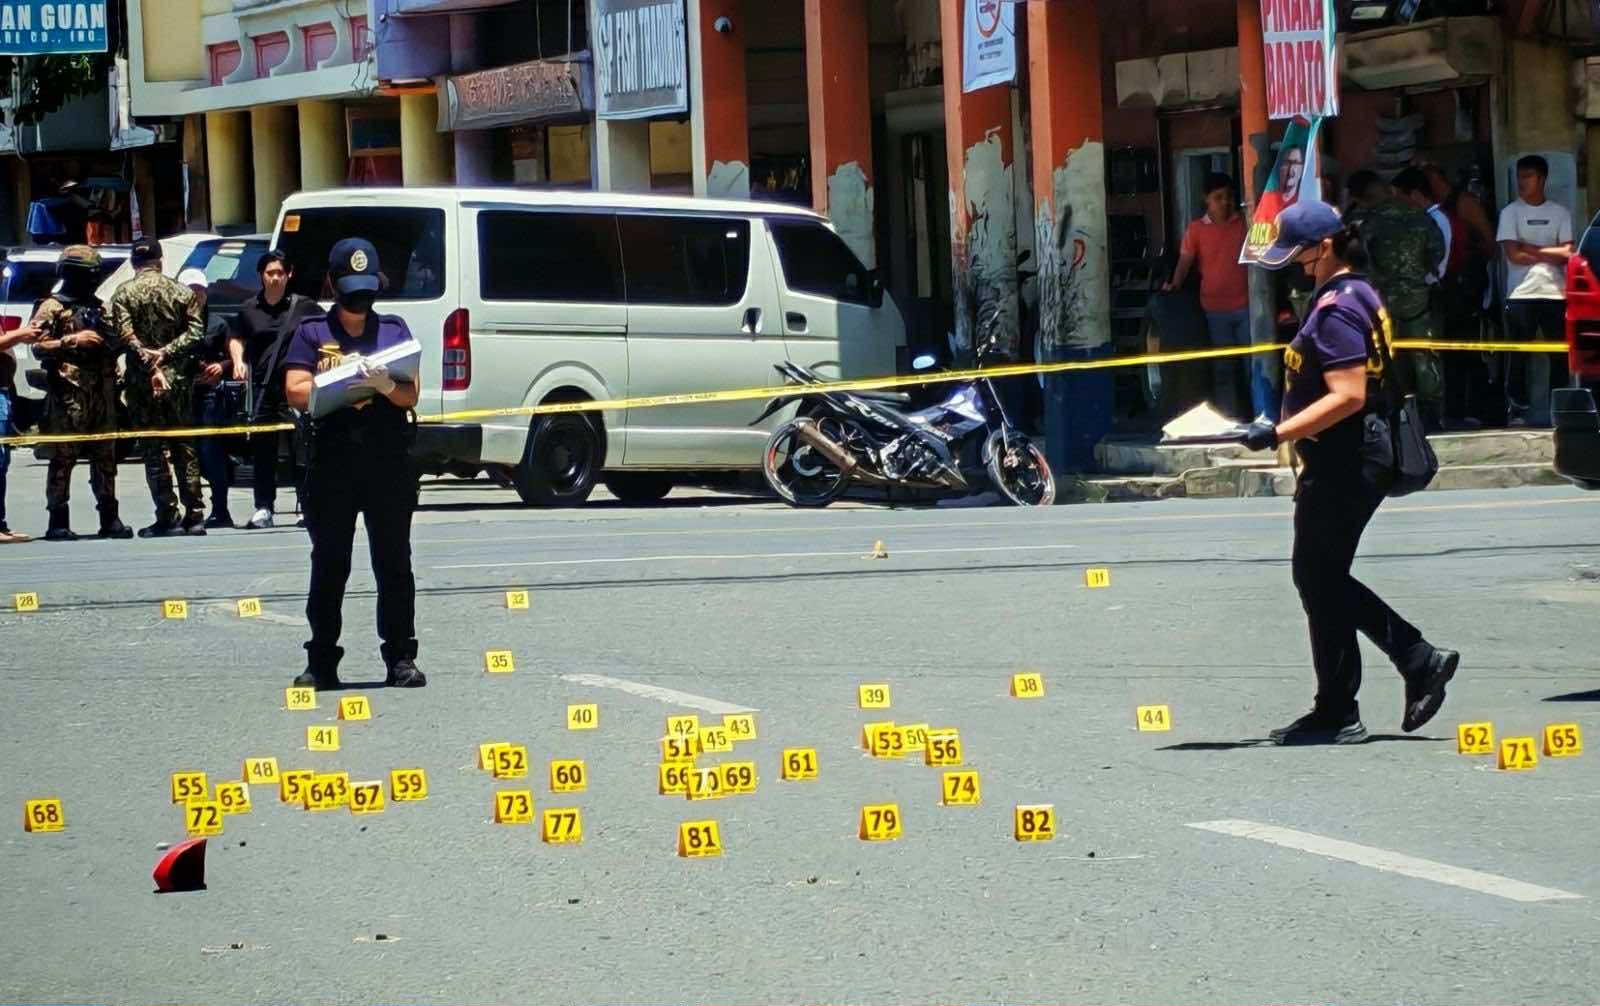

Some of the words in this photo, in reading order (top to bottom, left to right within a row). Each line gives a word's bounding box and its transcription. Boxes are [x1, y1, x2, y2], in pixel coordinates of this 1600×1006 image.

[41, 4, 104, 29] GUAN
[1264, 40, 1326, 112] BARATO
[491, 655, 508, 668] 35
[292, 690, 310, 704] 36
[865, 689, 884, 703] 39
[347, 701, 364, 715] 37
[572, 709, 592, 723] 40
[1144, 710, 1163, 724] 44
[674, 720, 695, 735] 42
[731, 719, 750, 735] 43
[906, 728, 925, 744] 50
[1464, 727, 1489, 746] 62
[315, 731, 332, 744] 41
[707, 731, 727, 749] 45
[879, 732, 903, 749] 53
[1552, 728, 1577, 748] 65
[668, 738, 693, 757] 51
[933, 740, 957, 759] 56
[1507, 743, 1532, 762] 71
[252, 762, 273, 777] 48
[499, 751, 525, 770] 52
[789, 753, 814, 772] 61
[397, 774, 422, 793] 59
[556, 765, 582, 784] 60
[692, 771, 719, 792] 70
[726, 766, 751, 786] 69
[178, 777, 203, 796] 55
[311, 782, 335, 802] 64
[354, 784, 380, 806] 67
[948, 776, 976, 797] 74
[220, 786, 246, 807] 63
[502, 795, 529, 815] 73
[32, 804, 58, 824] 68
[191, 806, 218, 827] 72
[549, 813, 577, 834] 77
[869, 810, 896, 831] 79
[1022, 810, 1051, 832] 82
[688, 826, 716, 848] 81
